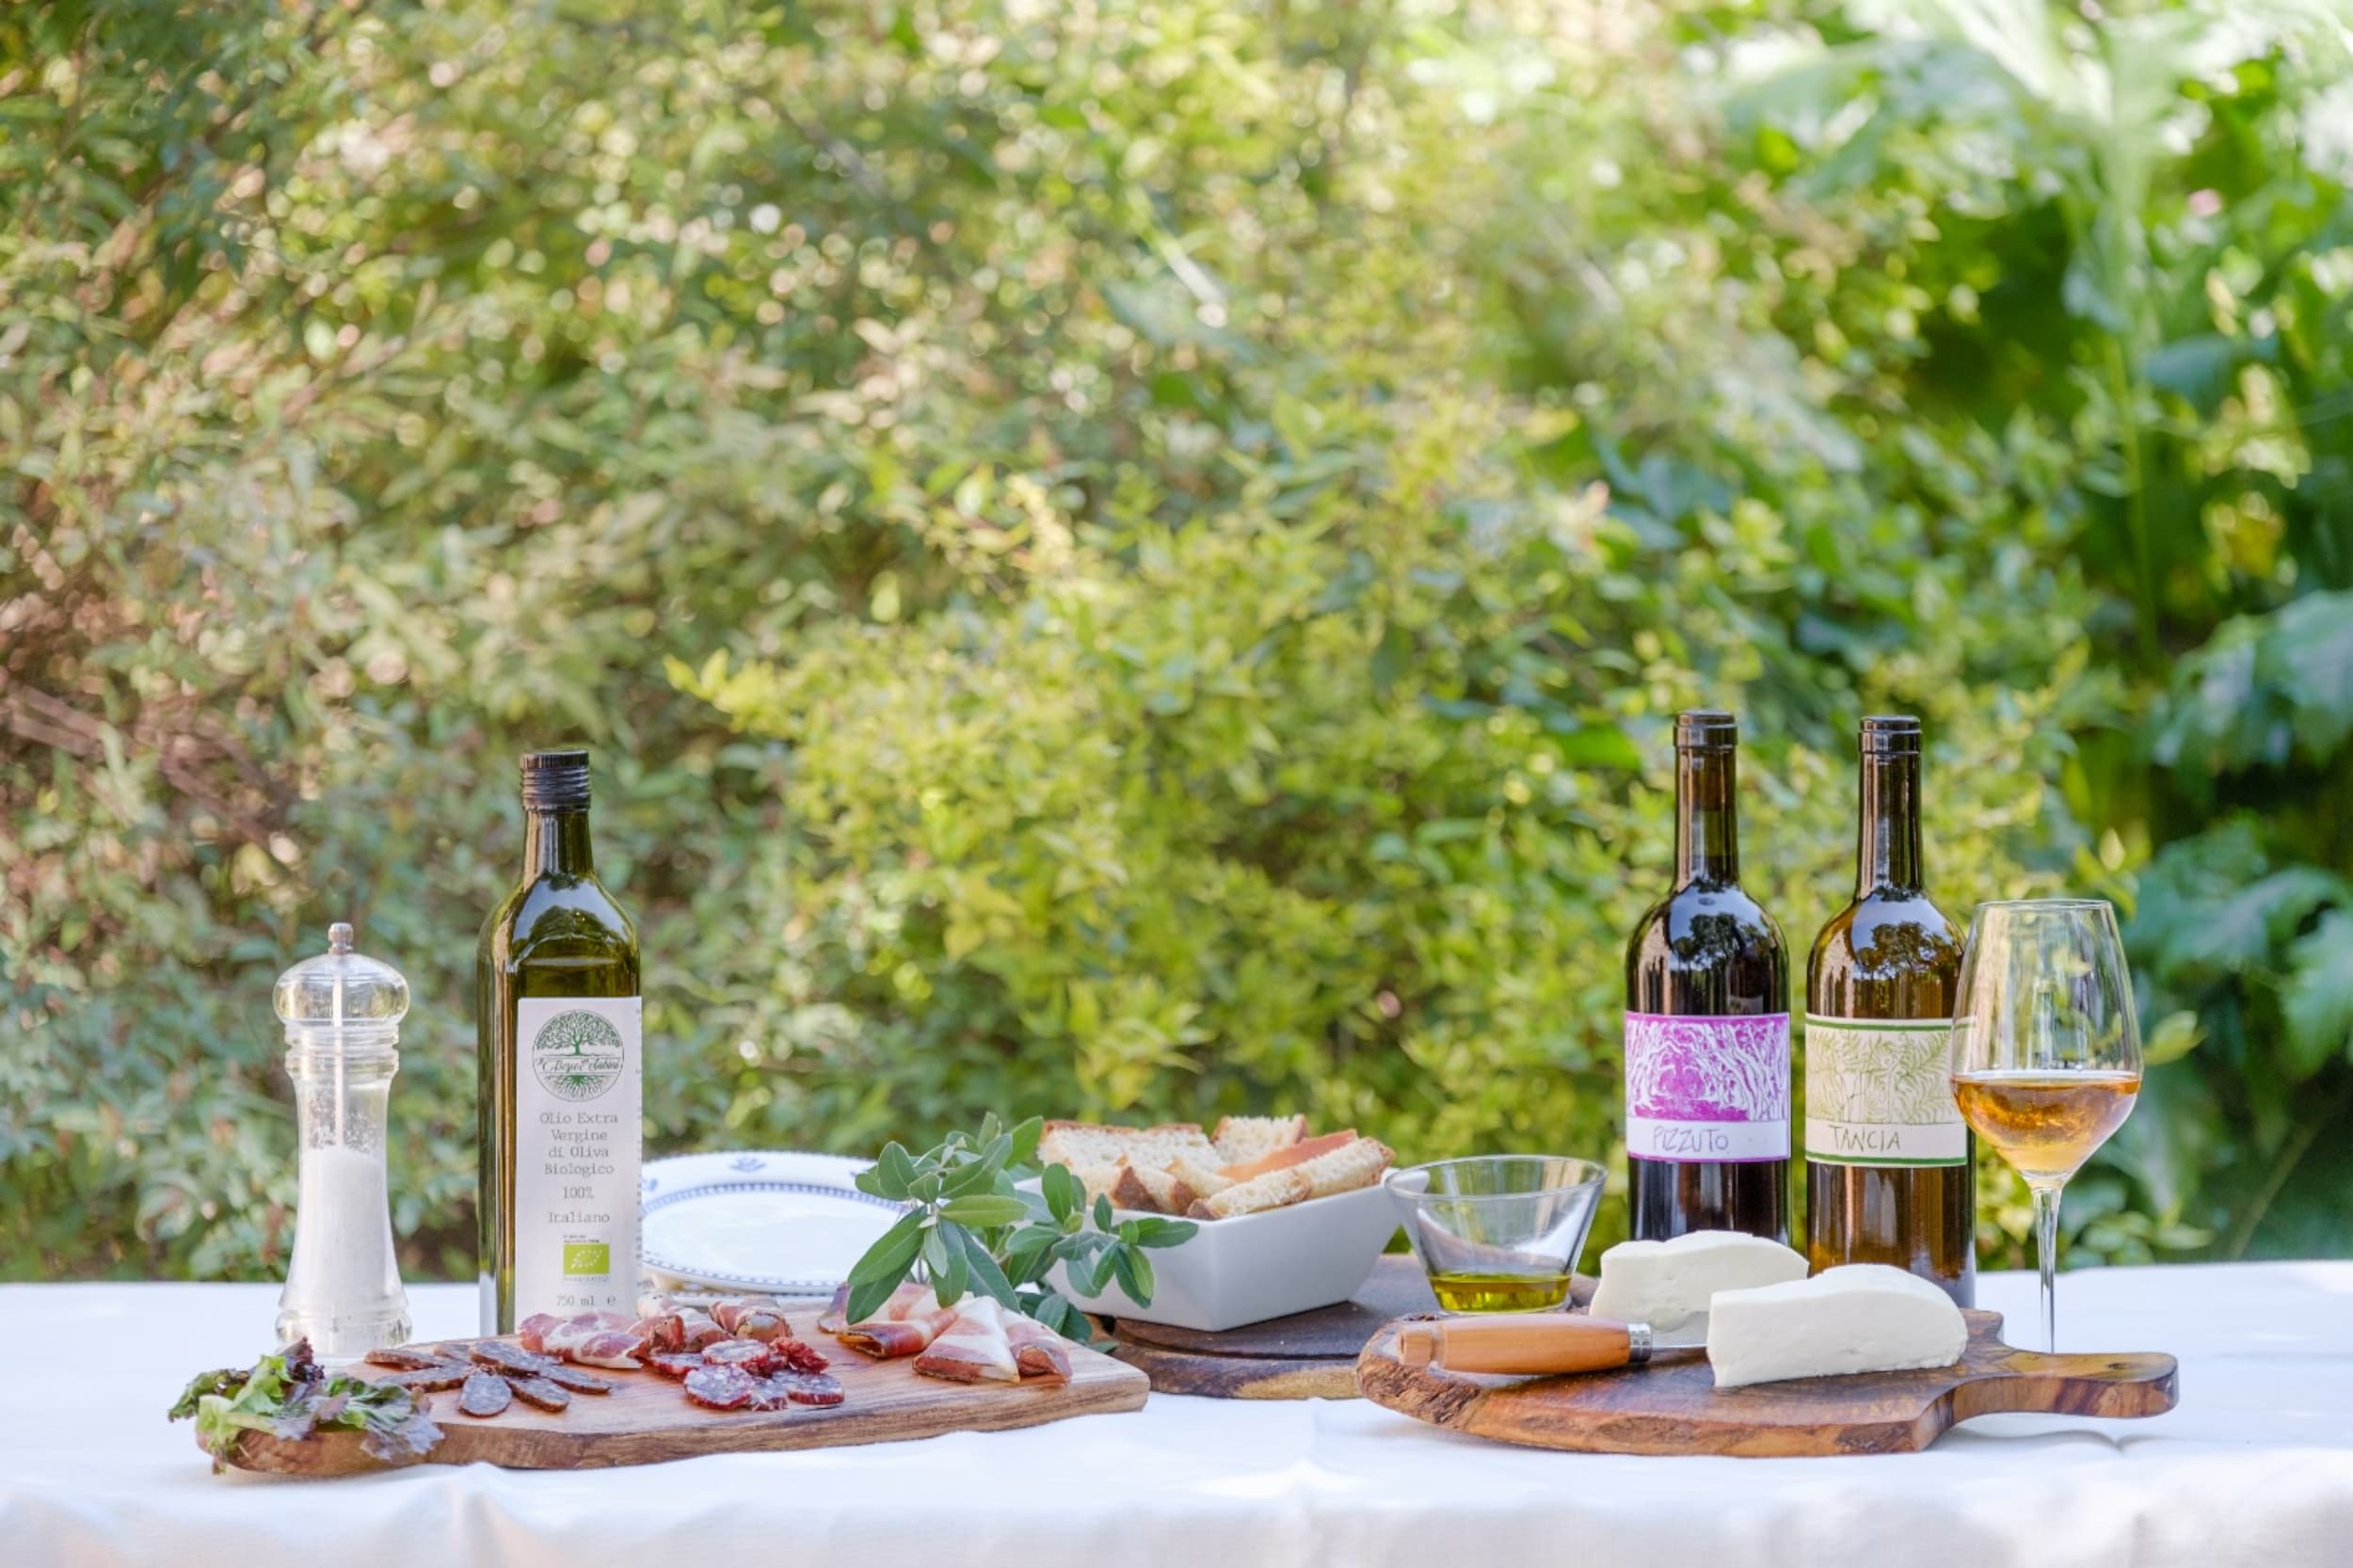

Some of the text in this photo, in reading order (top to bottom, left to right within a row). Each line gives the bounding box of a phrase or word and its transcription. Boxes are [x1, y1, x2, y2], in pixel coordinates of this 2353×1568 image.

[539, 1112, 618, 1124] Olio Extra
[552, 1129, 608, 1144] Vergine
[1653, 1125, 1729, 1153] PIZZUTO
[1829, 1124, 1901, 1153] TANCIA
[548, 1146, 609, 1158] di Oliva
[544, 1163, 615, 1178] Biologico
[563, 1186, 595, 1199] 100%
[548, 1211, 611, 1224] Italiano
[581, 1295, 595, 1306] ml
